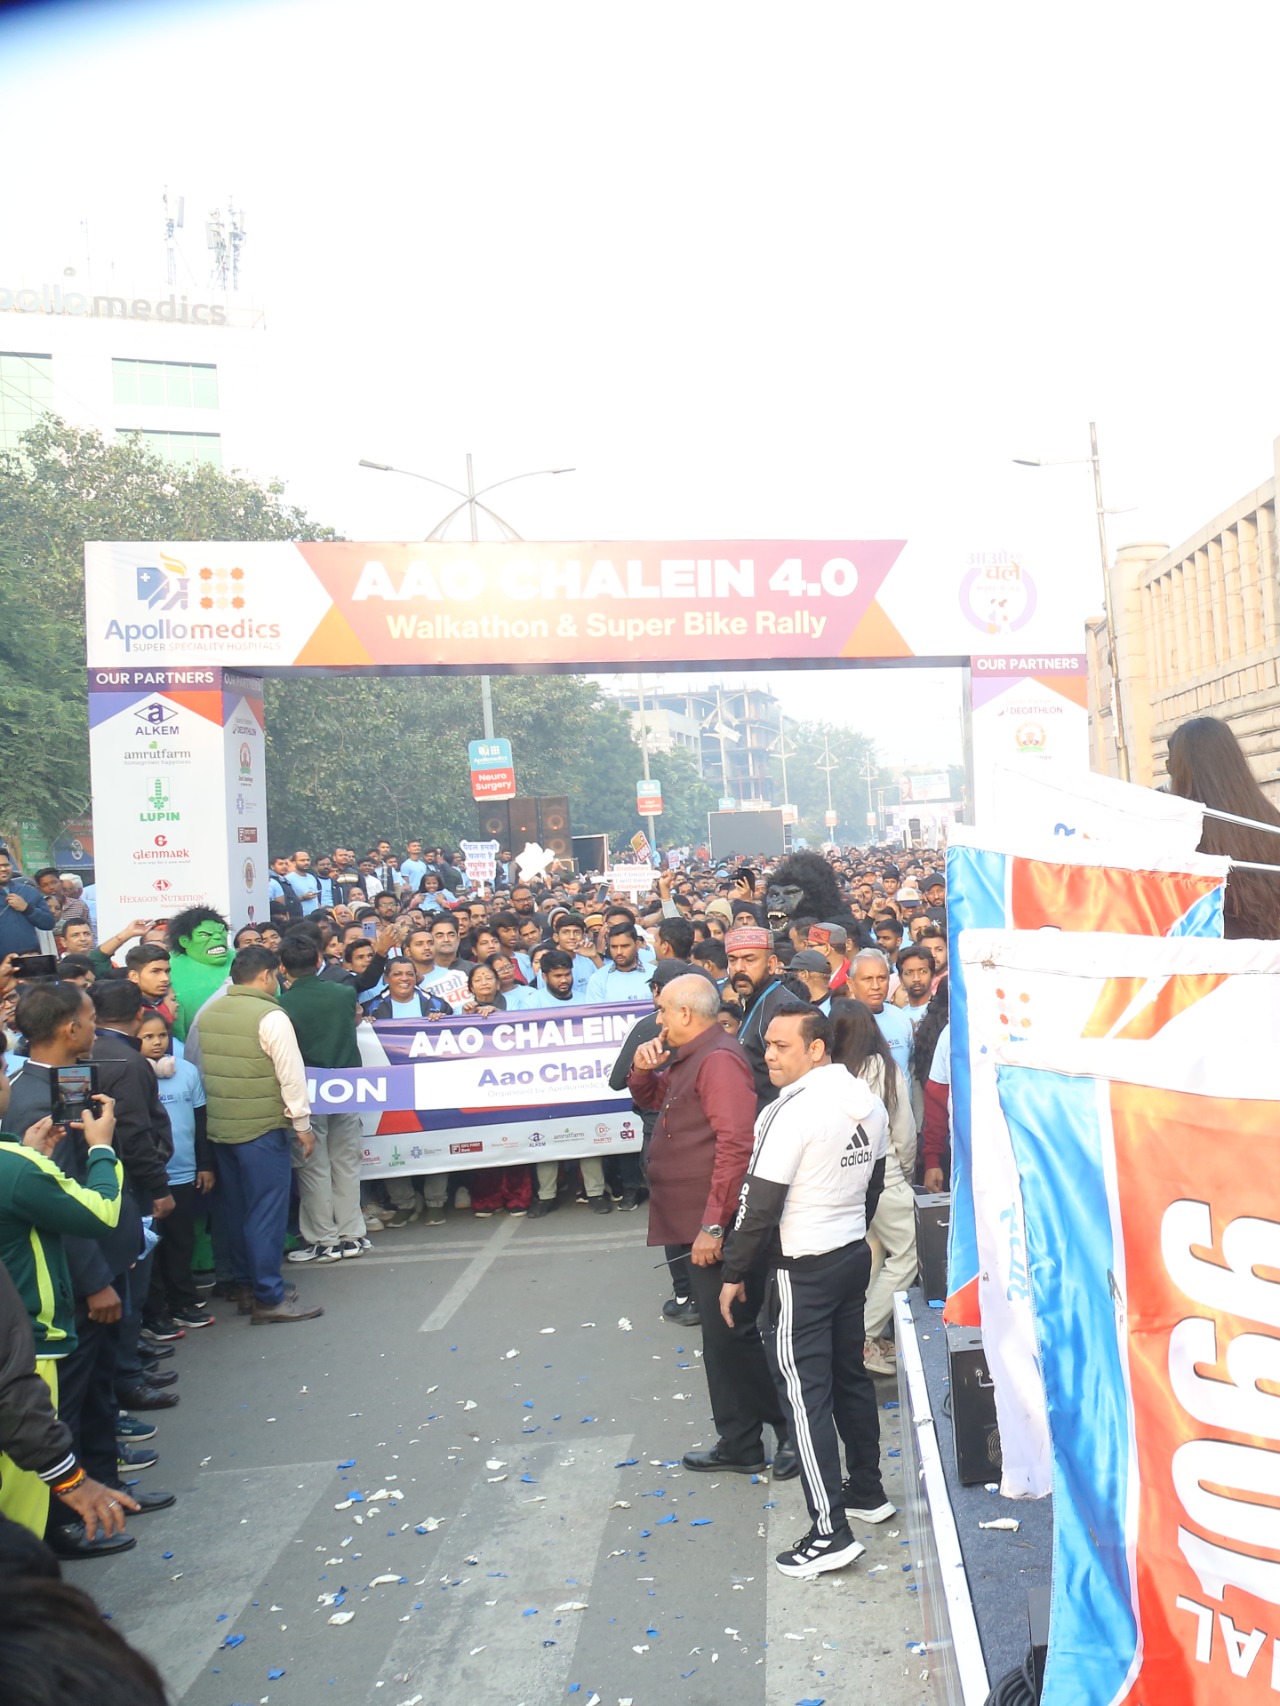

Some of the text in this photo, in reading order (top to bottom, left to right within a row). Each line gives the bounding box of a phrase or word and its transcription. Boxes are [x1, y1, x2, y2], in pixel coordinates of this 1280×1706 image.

[351, 557, 859, 600] AAO CHALEIN 4.0
[386, 610, 827, 642] Walkathon & Super Bike Rally
[104, 618, 281, 652] Apollomedics
[133, 642, 281, 651] SUPER SPECIALITY HOSPITALS
[977, 657, 1079, 670] OUR PARTNERS
[96, 672, 215, 684] OUR PARTNERS
[1010, 706, 1063, 714] DECATHLON
[135, 726, 180, 735] ALKEM
[124, 749, 191, 759] amrutfarm
[478, 773, 507, 781] Neuro
[475, 781, 512, 791] Surgery
[140, 812, 180, 821] LUPIN
[408, 1026, 484, 1058] AAO
[478, 1060, 614, 1087] Aao Chale
[487, 1086, 533, 1098] Organised
[548, 1083, 605, 1092] Apollomedics
[840, 1150, 873, 1168] adidas
